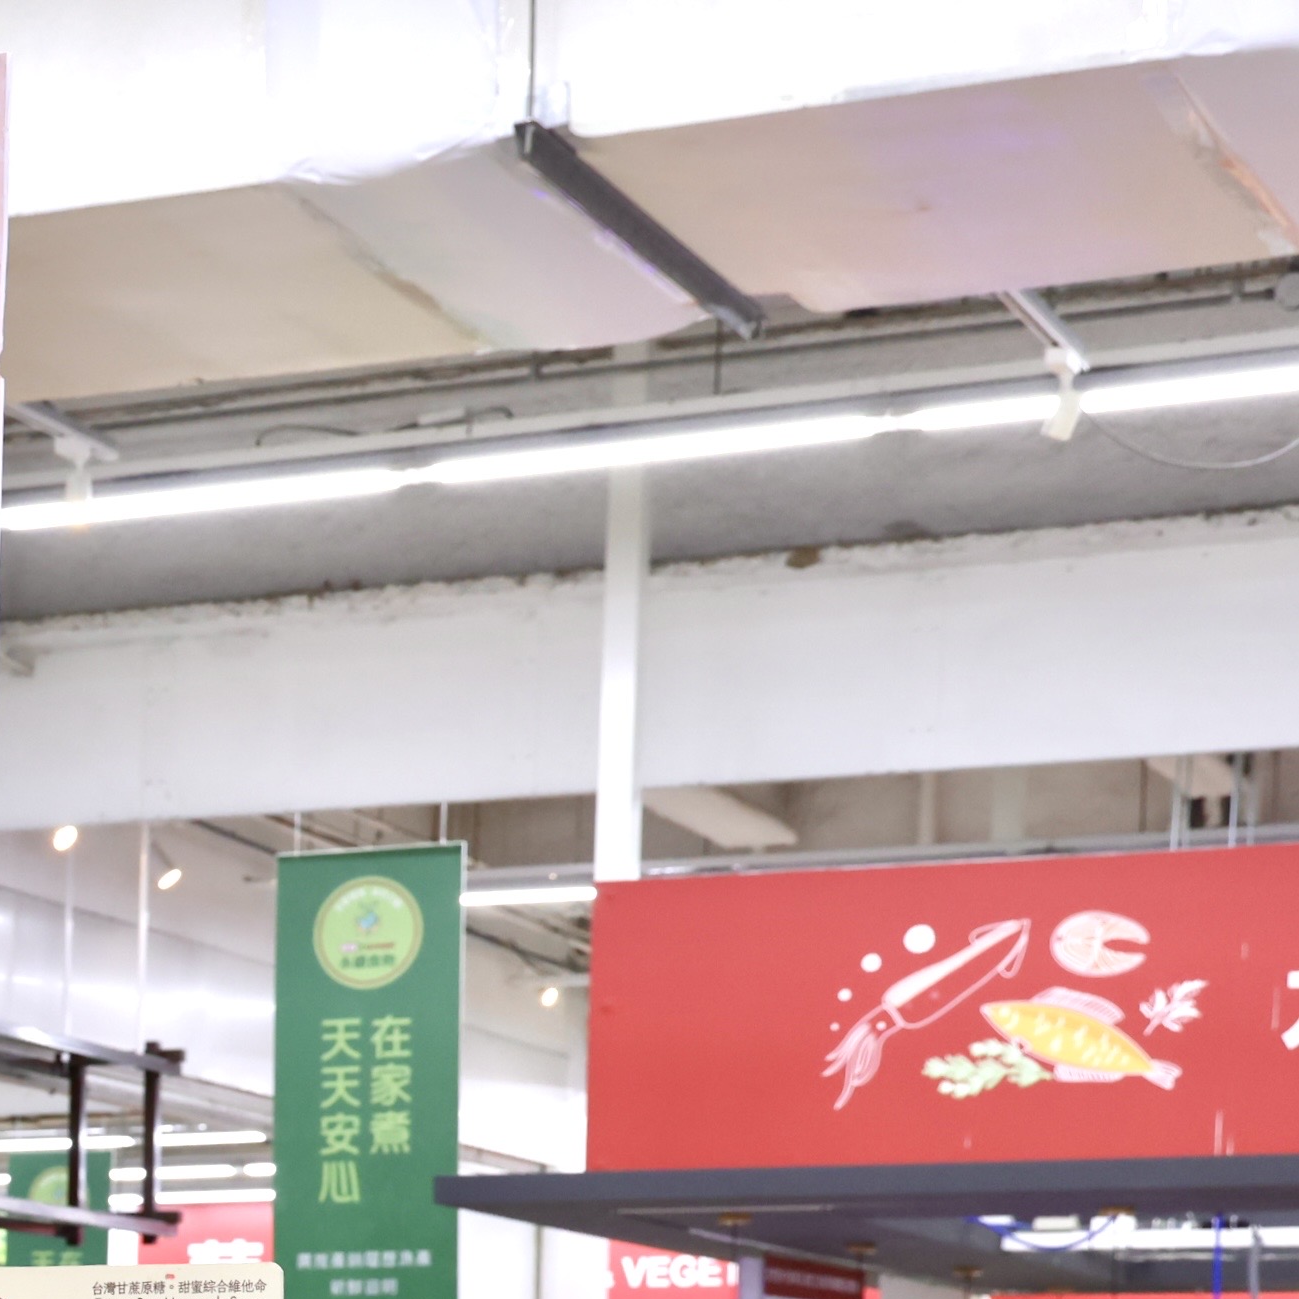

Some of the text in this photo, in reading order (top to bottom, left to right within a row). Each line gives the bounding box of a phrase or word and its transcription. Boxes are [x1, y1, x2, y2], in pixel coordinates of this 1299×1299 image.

[318, 1018, 362, 1203] 天天安心
[370, 1014, 412, 1154] 在家煮
